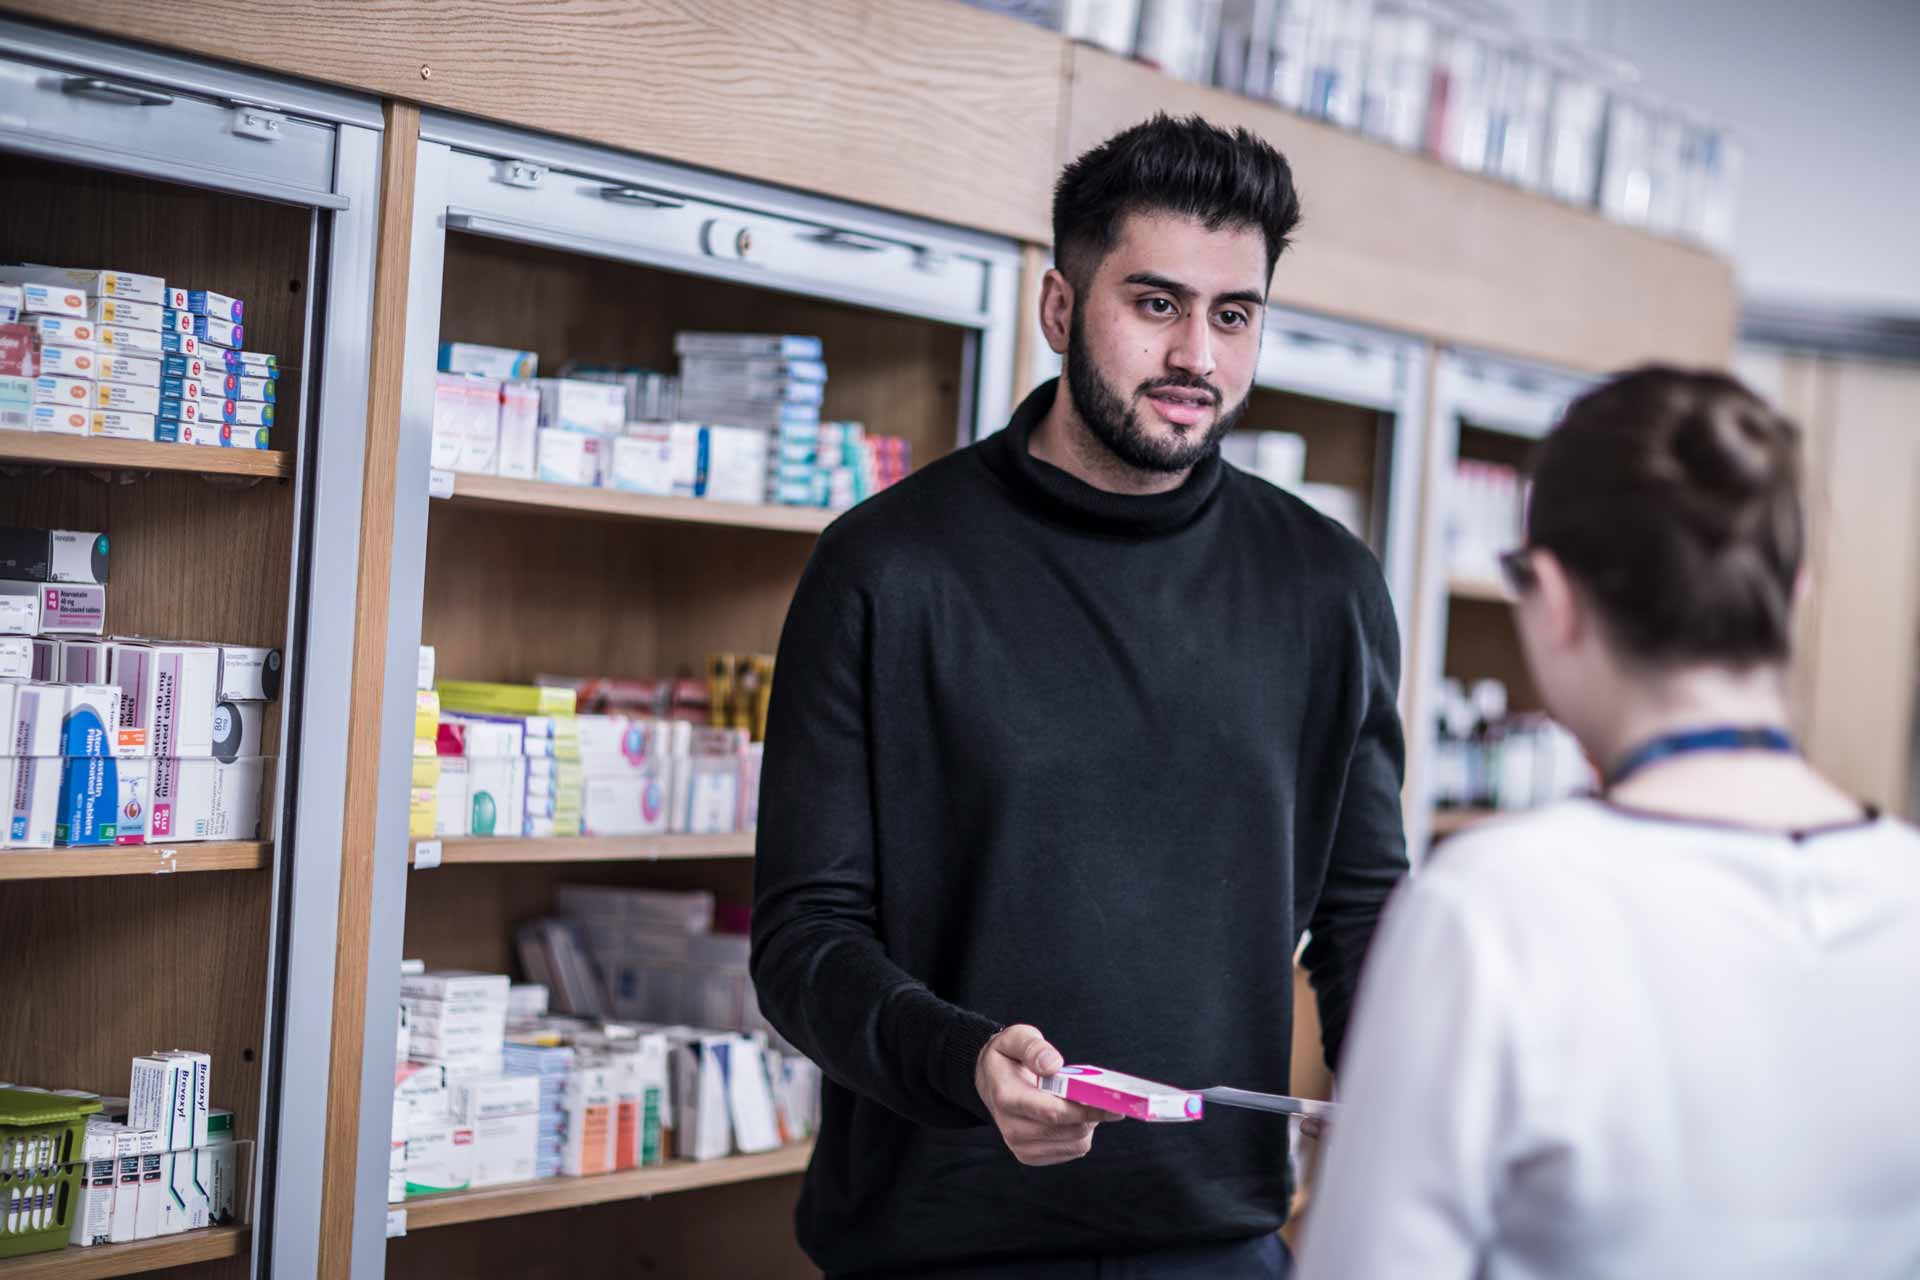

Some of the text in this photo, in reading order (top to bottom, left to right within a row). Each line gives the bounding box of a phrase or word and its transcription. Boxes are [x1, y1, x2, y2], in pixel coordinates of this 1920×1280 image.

[157, 671, 167, 692] mg
[156, 695, 164, 712] 40
[163, 675, 173, 720] tablets
[214, 717, 222, 731] 80
[84, 796, 95, 836] Tablets
[154, 812, 162, 828] 40
[161, 809, 169, 830] mg
[177, 1069, 190, 1118] Brevoxyl
[197, 1063, 208, 1111] Brevoxyl
